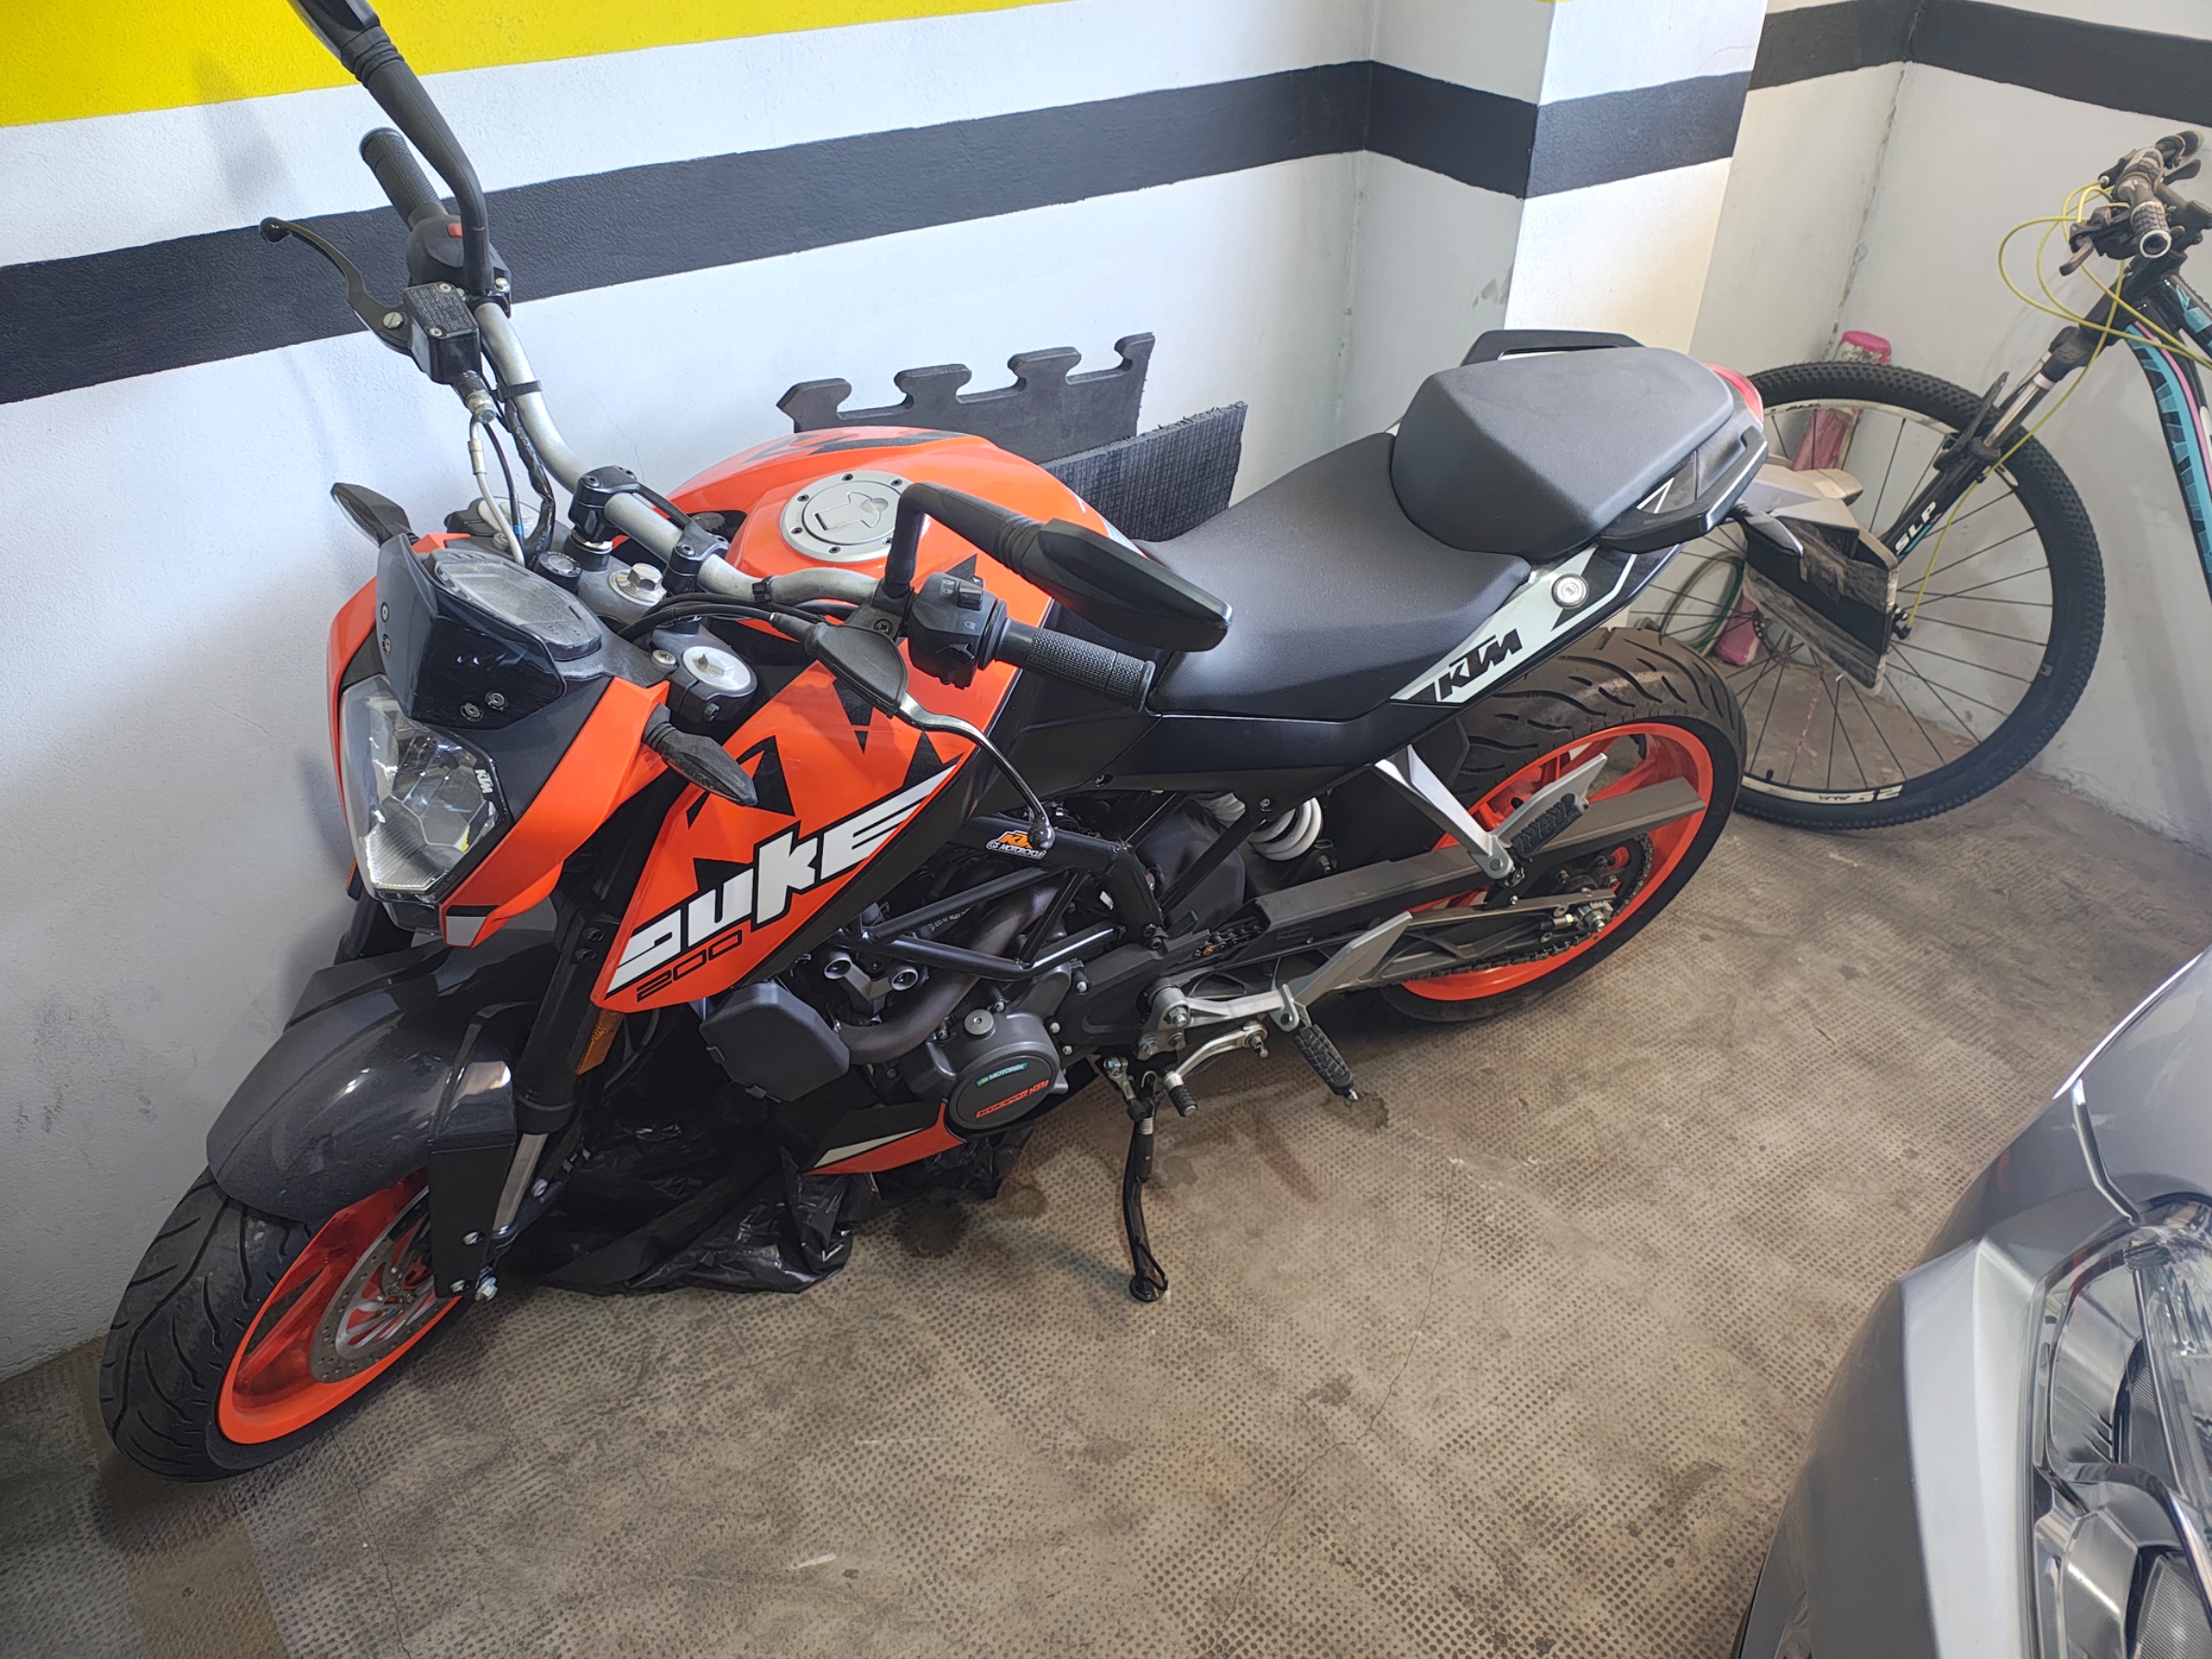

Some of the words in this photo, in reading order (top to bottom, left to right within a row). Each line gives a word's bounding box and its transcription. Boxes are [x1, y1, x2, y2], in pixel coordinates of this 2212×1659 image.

[1895, 501, 1936, 555] SLP
[1438, 628, 1523, 700] KTM
[475, 769, 495, 794] KTM
[636, 929, 743, 1003] 200
